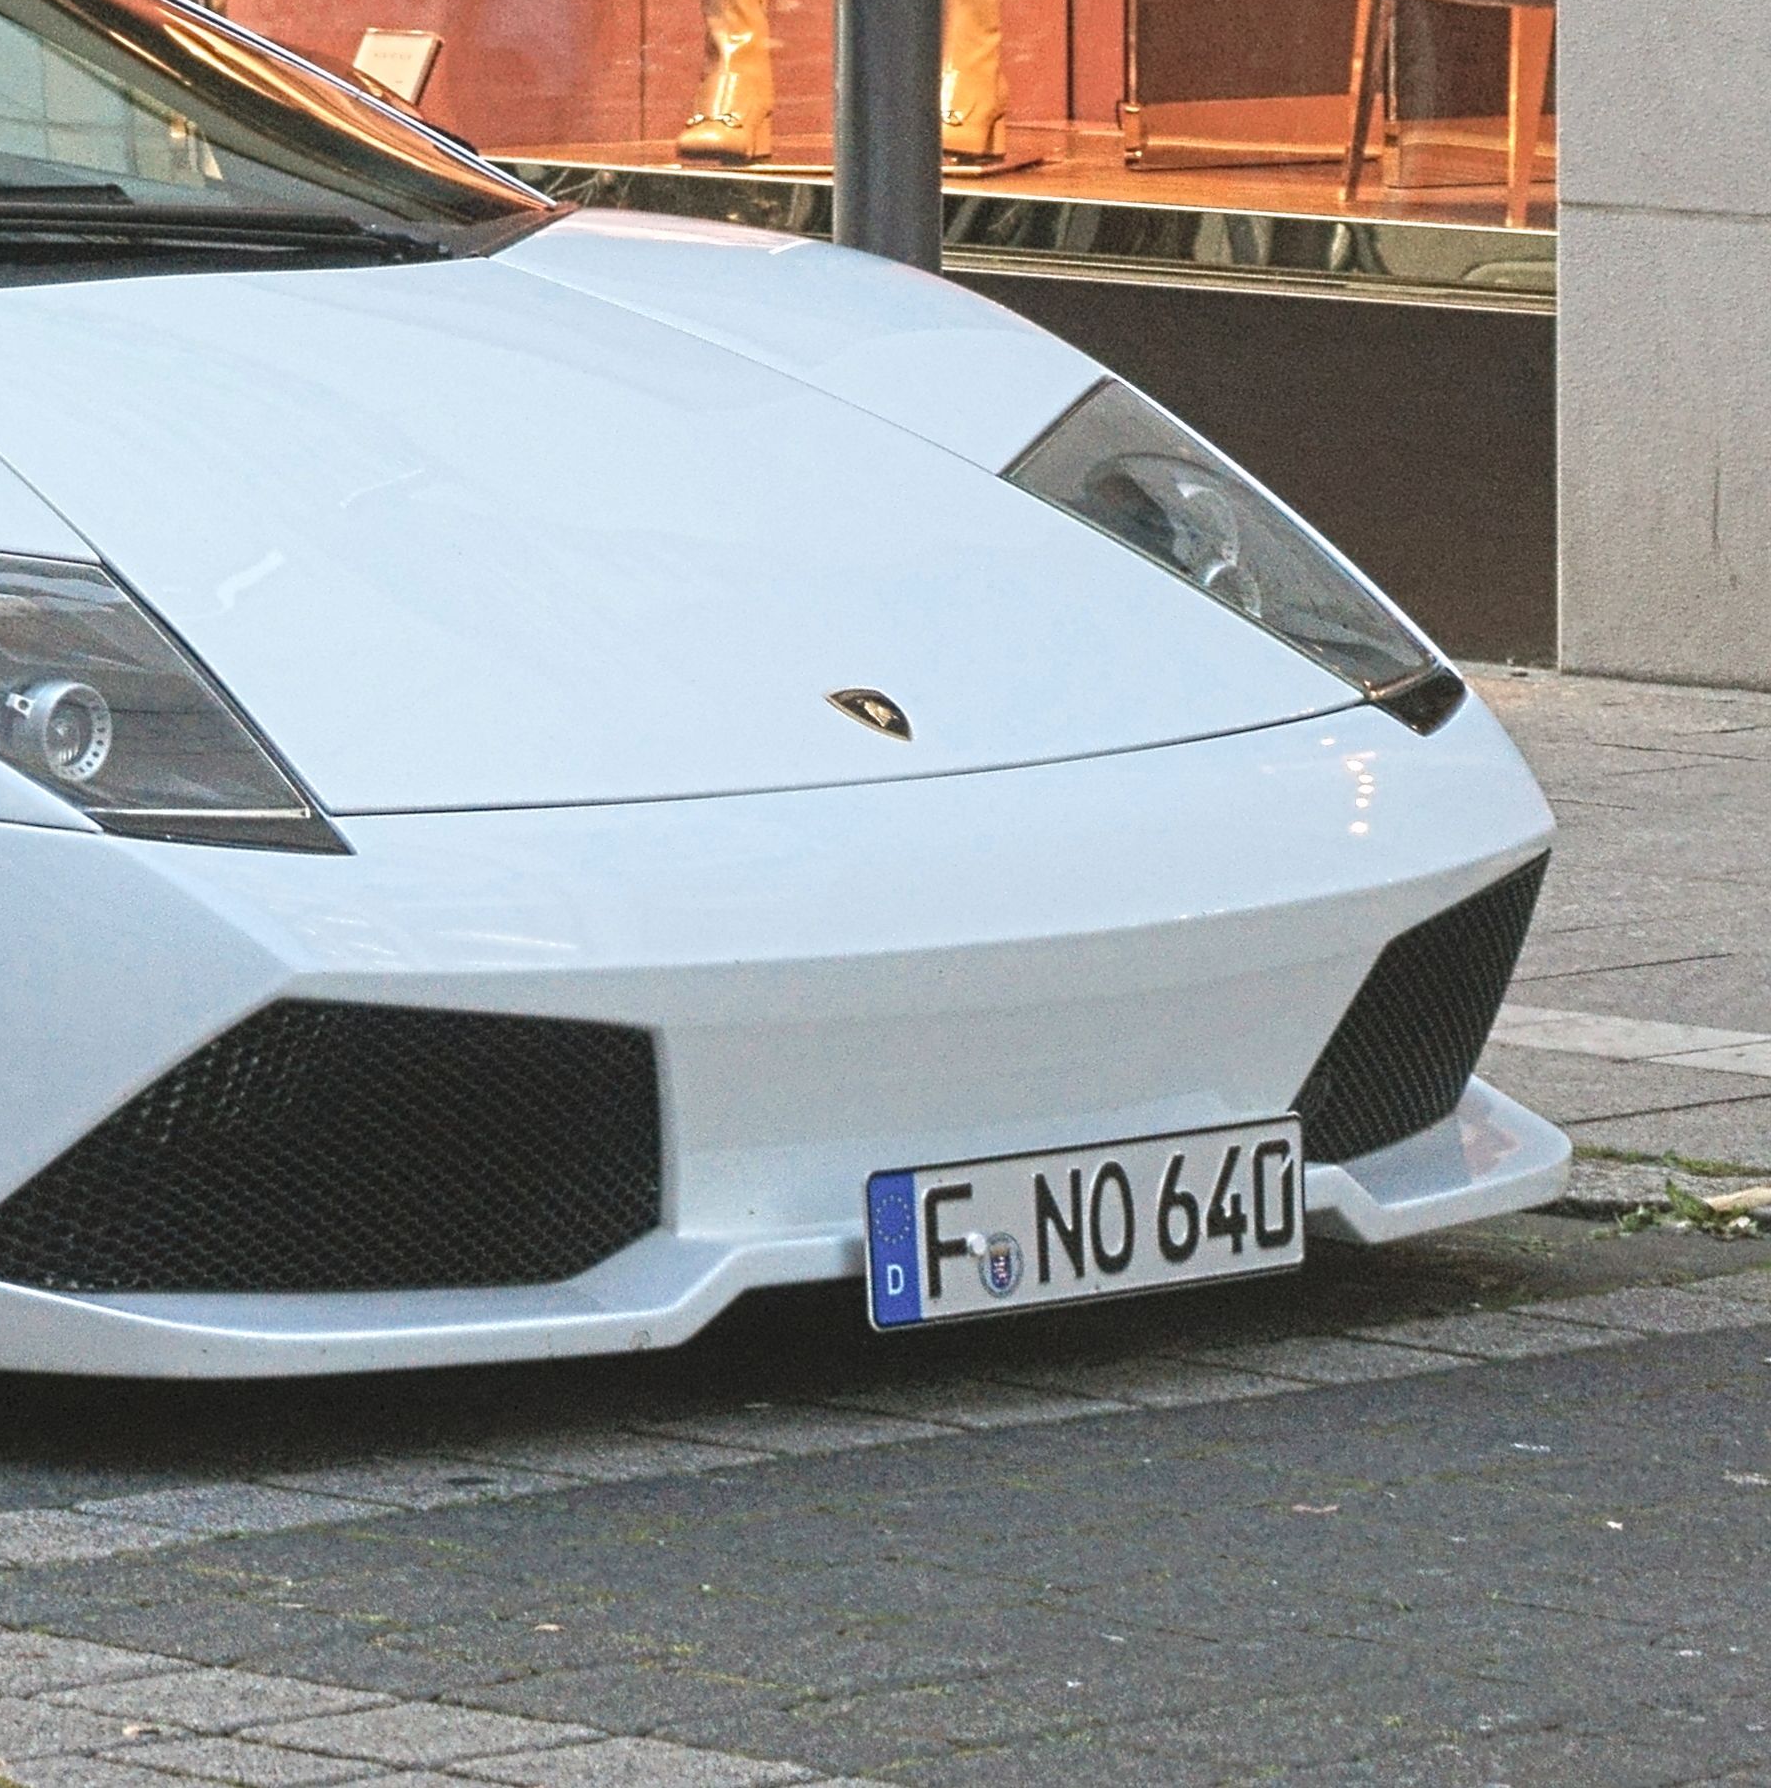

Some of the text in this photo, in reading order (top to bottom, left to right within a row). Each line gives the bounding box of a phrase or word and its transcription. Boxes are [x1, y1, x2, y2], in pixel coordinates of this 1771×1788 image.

[924, 1138, 1294, 1299] F NO 640
[887, 1264, 904, 1295] D
